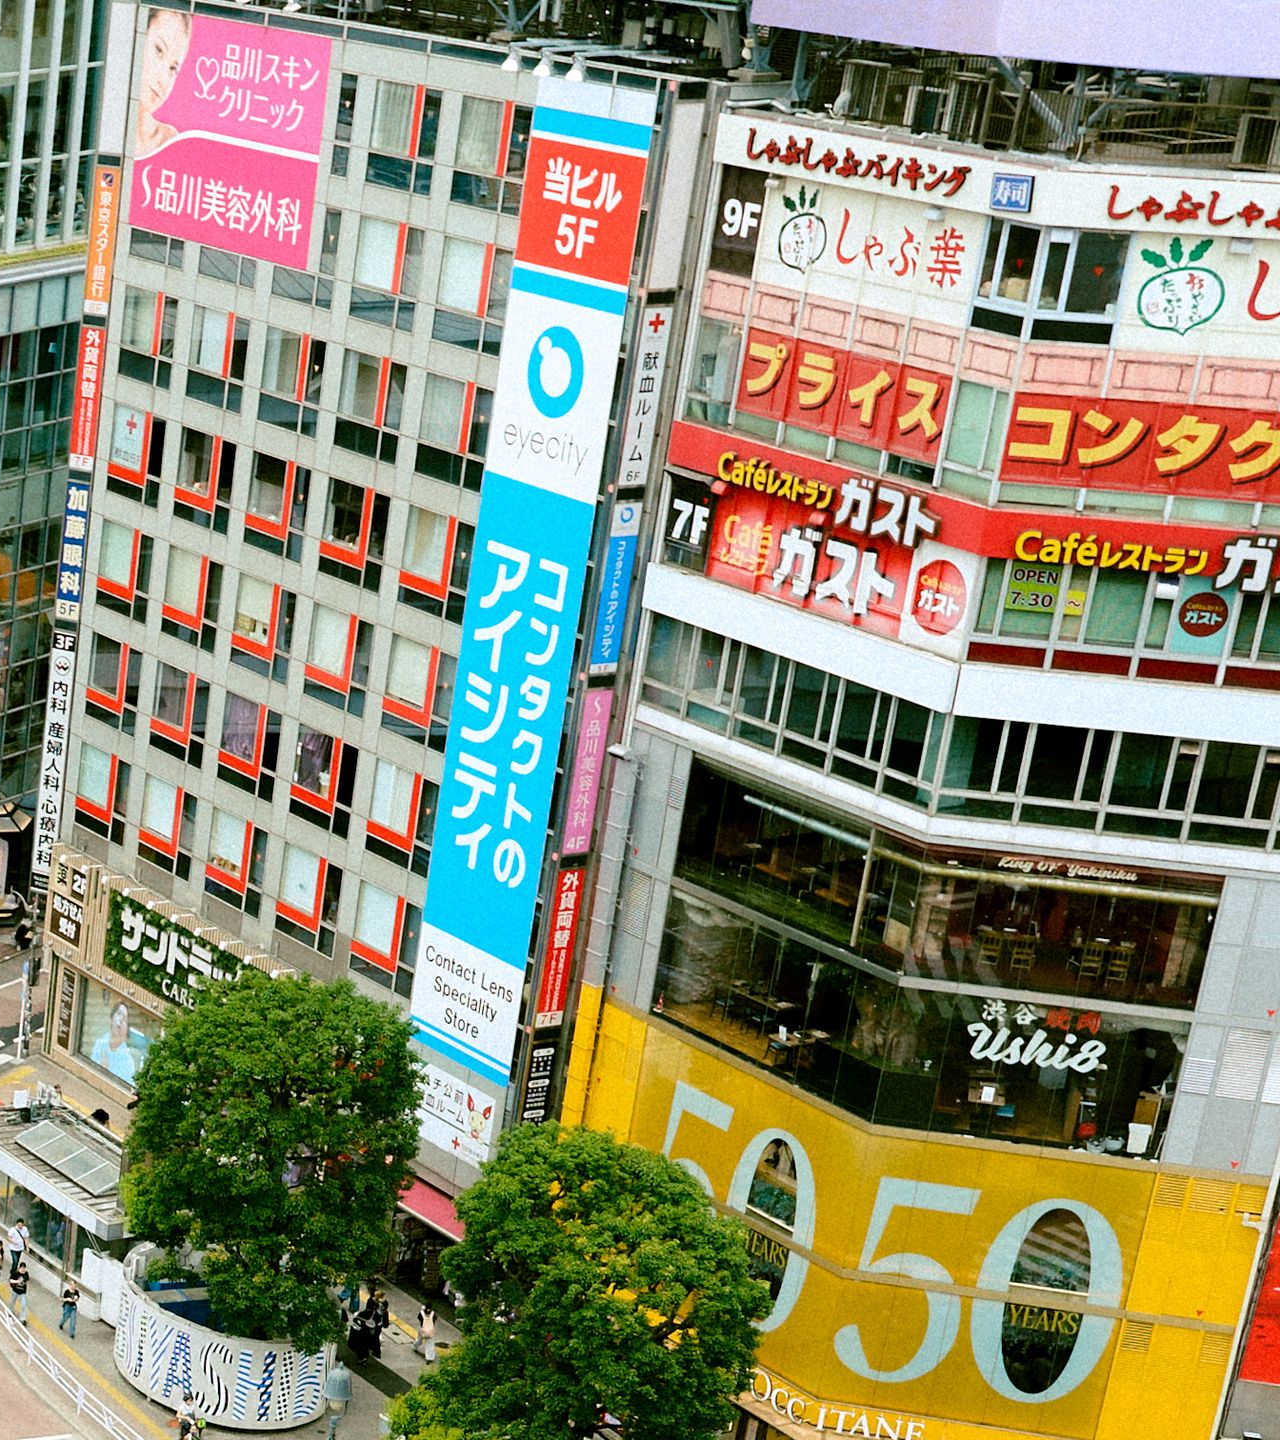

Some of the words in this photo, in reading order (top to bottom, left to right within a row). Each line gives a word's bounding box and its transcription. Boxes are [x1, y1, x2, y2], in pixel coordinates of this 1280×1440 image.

[221, 43, 320, 91] 品川スキン
[218, 86, 304, 132] クリニック
[542, 157, 623, 213] 当ビル
[747, 127, 972, 197] しゃぶしゃぶバイキング
[154, 169, 302, 246] 品川美容外科
[993, 179, 1028, 208] 寿司
[554, 214, 599, 259] 5F
[721, 198, 762, 238] 9F
[90, 190, 112, 298] 東京スター銀行
[836, 208, 966, 288] しゃぶ葉
[628, 351, 660, 462] 献血ルーム
[746, 341, 943, 442] プライス
[503, 421, 589, 477] eyecity
[625, 470, 640, 482] 6F
[672, 498, 710, 545] 7F
[723, 515, 774, 556] Café
[834, 477, 941, 548] ガスト
[59, 486, 89, 595] 加藤眼科
[1015, 530, 1209, 575] Caféレストラン
[773, 527, 896, 616] ガスト
[1013, 568, 1059, 585] OPEN
[58, 602, 77, 617] 5F
[917, 589, 960, 617] ガスト
[1010, 590, 1054, 608] 7:30
[1183, 611, 1223, 626] ガスト
[55, 635, 74, 651] 3F
[50, 680, 67, 715] 内科
[451, 539, 532, 870] アイシティ
[493, 558, 569, 889] コンタクトの
[571, 719, 603, 829] 品川美容外科
[566, 834, 588, 852] 4F
[998, 856, 1034, 873] King
[1067, 863, 1138, 882] Yakiniku
[553, 871, 579, 949] 外貨両替
[426, 944, 479, 983] Contact
[481, 970, 514, 1004] Lens
[432, 975, 500, 1025] Speciality
[443, 1006, 480, 1036] Store
[540, 1013, 559, 1026] 7F
[967, 1022, 1108, 1074] Ushi8
[425, 1093, 465, 1126] 血ルーム
[743, 1230, 789, 1269] YEARS
[834, 1177, 1123, 1403] 50
[1009, 1303, 1081, 1336] YEARS
